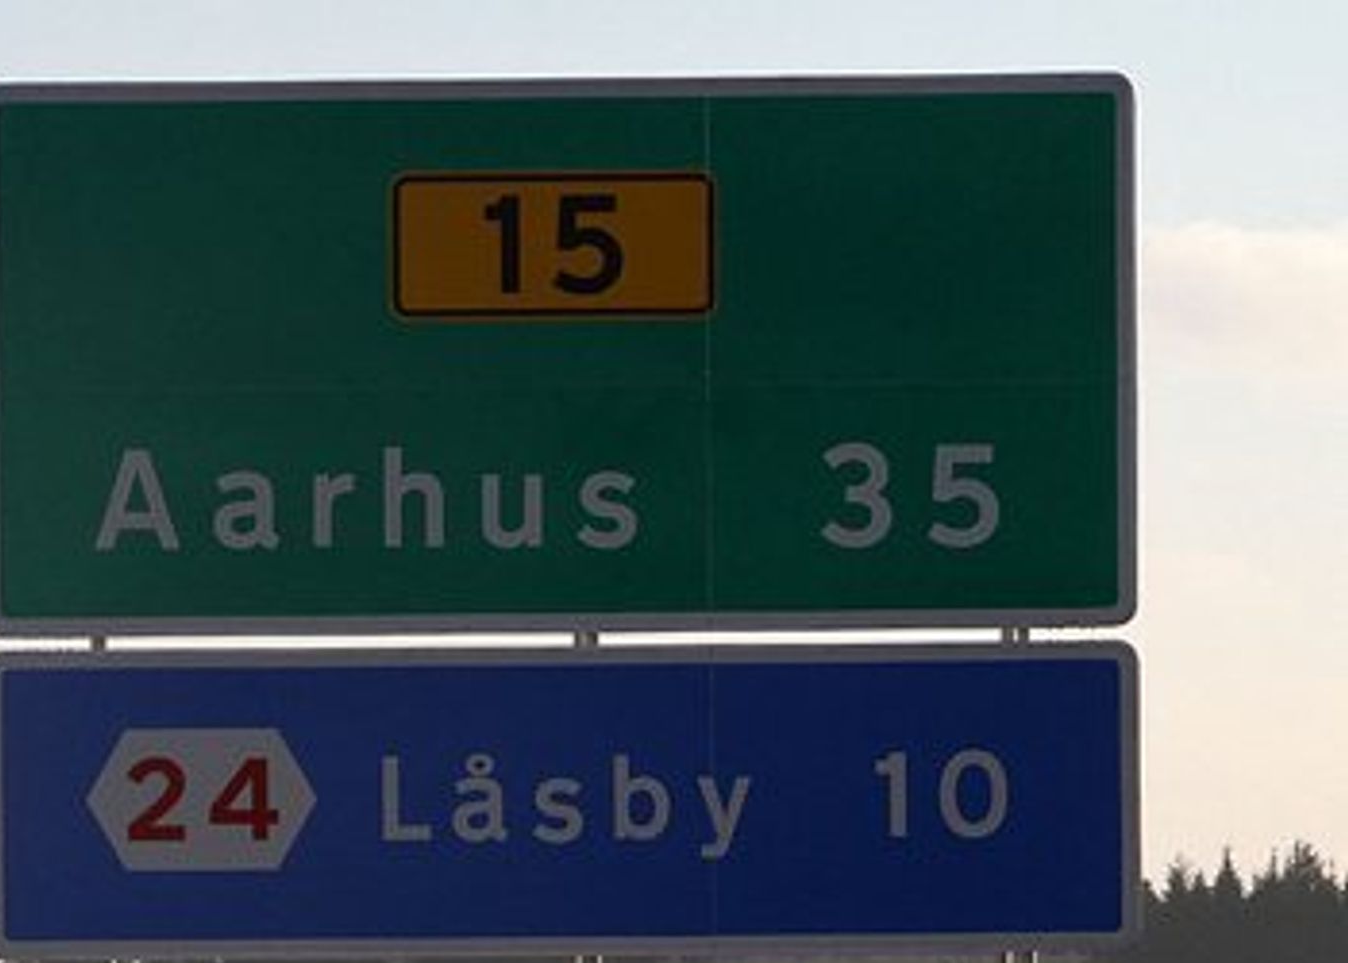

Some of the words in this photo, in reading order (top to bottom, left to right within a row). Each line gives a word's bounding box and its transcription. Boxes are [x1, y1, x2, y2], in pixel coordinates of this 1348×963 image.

[484, 193, 624, 294] 15
[96, 447, 639, 551] Aarhus
[822, 443, 1000, 549] 35
[125, 755, 279, 842] 24
[380, 753, 751, 858] Låsby
[873, 749, 1009, 837] 10
